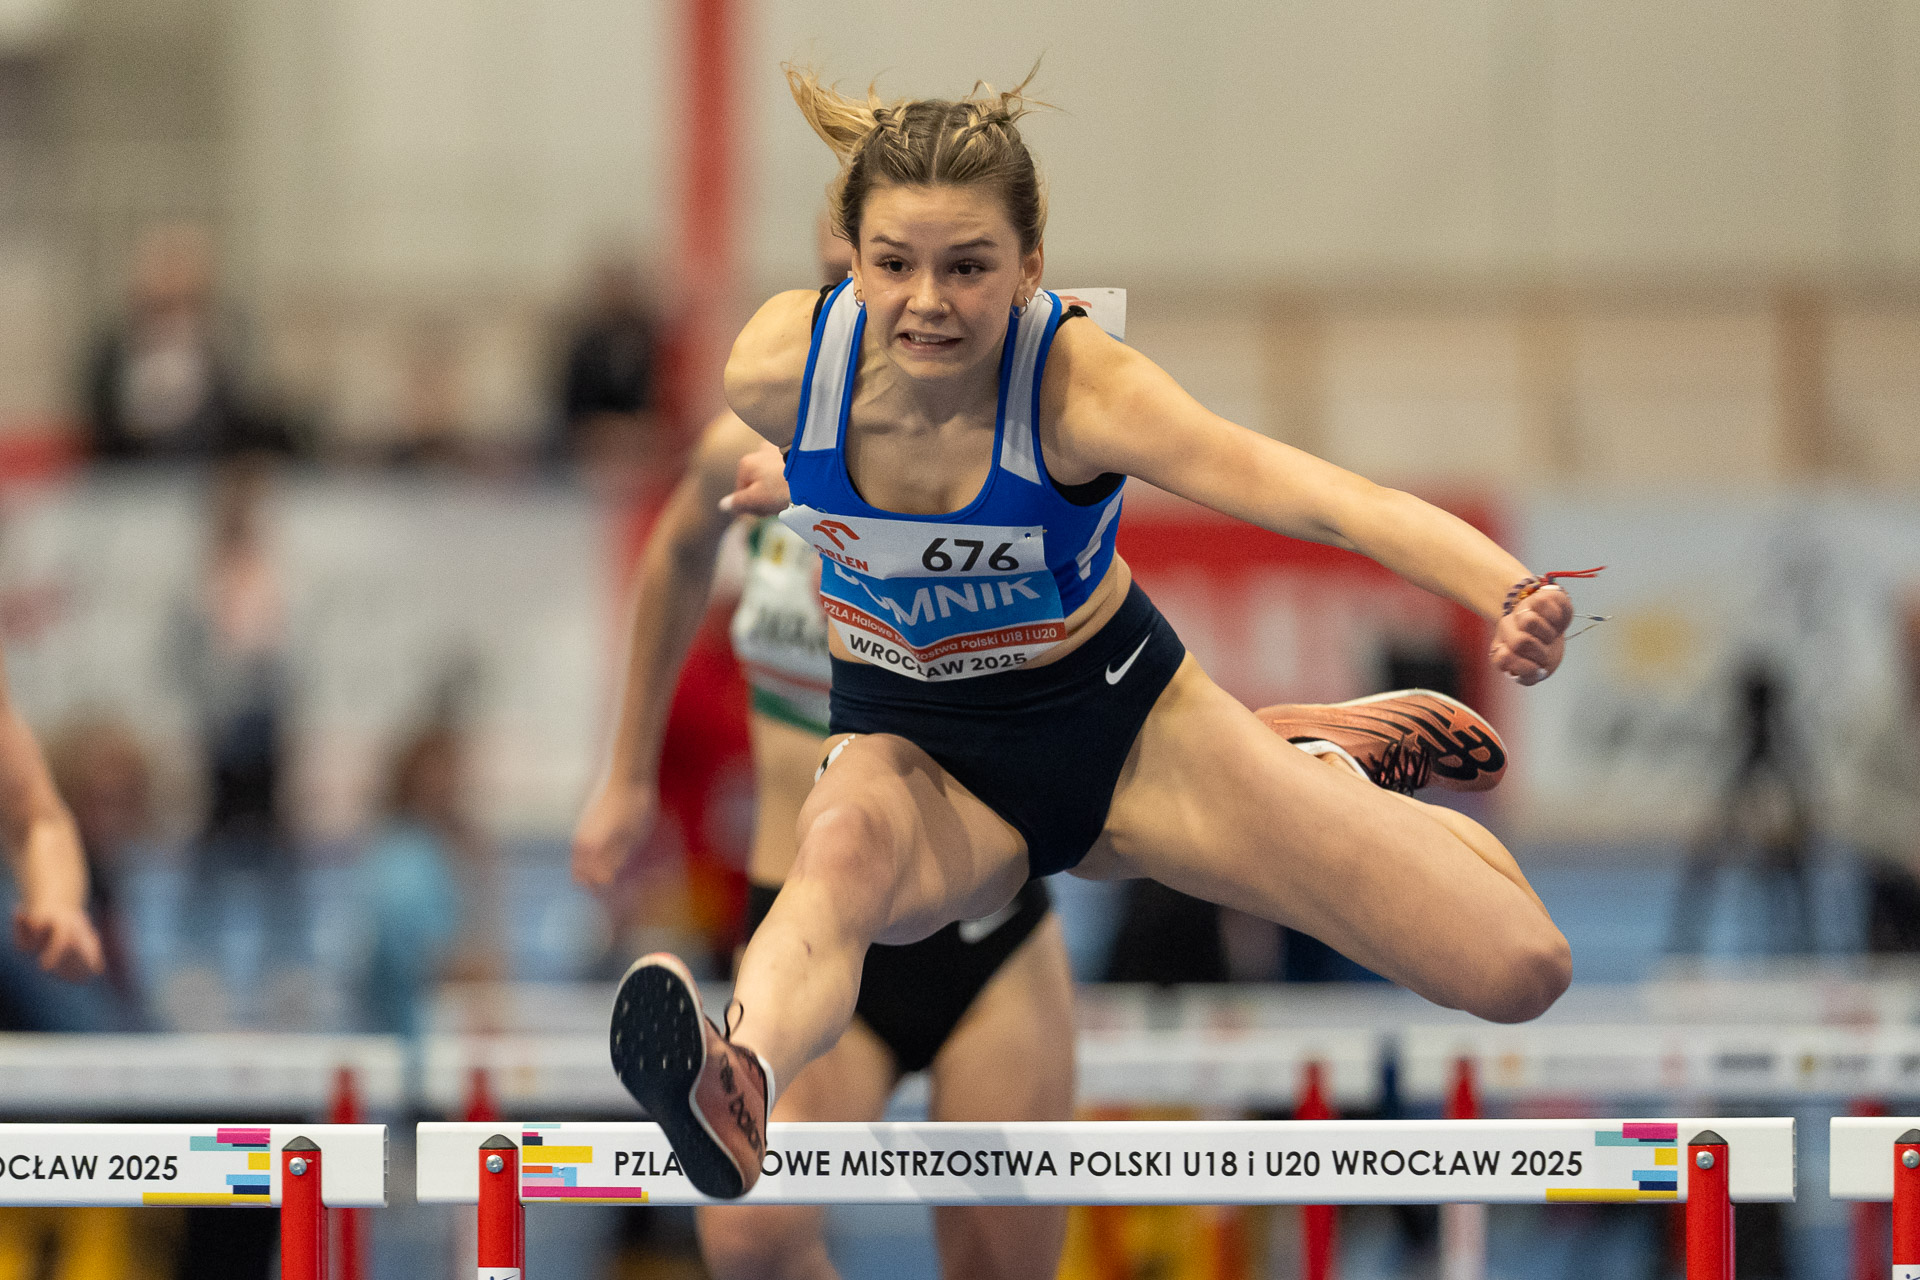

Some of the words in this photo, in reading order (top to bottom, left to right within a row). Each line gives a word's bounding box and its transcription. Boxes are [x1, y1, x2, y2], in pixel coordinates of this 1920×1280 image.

[922, 537, 1020, 572] 676
[823, 601, 849, 619] PZLA
[851, 612, 893, 637] Halowe
[960, 635, 998, 649] Polski
[1001, 630, 1023, 643] U18
[1032, 627, 1057, 640] U20
[970, 652, 1028, 672] 2025
[0, 1154, 98, 1180] CŁAW
[108, 1154, 178, 1181] 2025
[615, 1151, 684, 1176] PZLA
[761, 1150, 830, 1176] OWE
[841, 1150, 1058, 1177] MISTRZOSTWA
[1070, 1151, 1171, 1177] POLSKI
[1184, 1151, 1238, 1177] U18
[1248, 1150, 1254, 1176] i
[1266, 1151, 1320, 1177] U20
[1331, 1149, 1500, 1176] WROCŁAW
[1510, 1150, 1582, 1177] 2025
